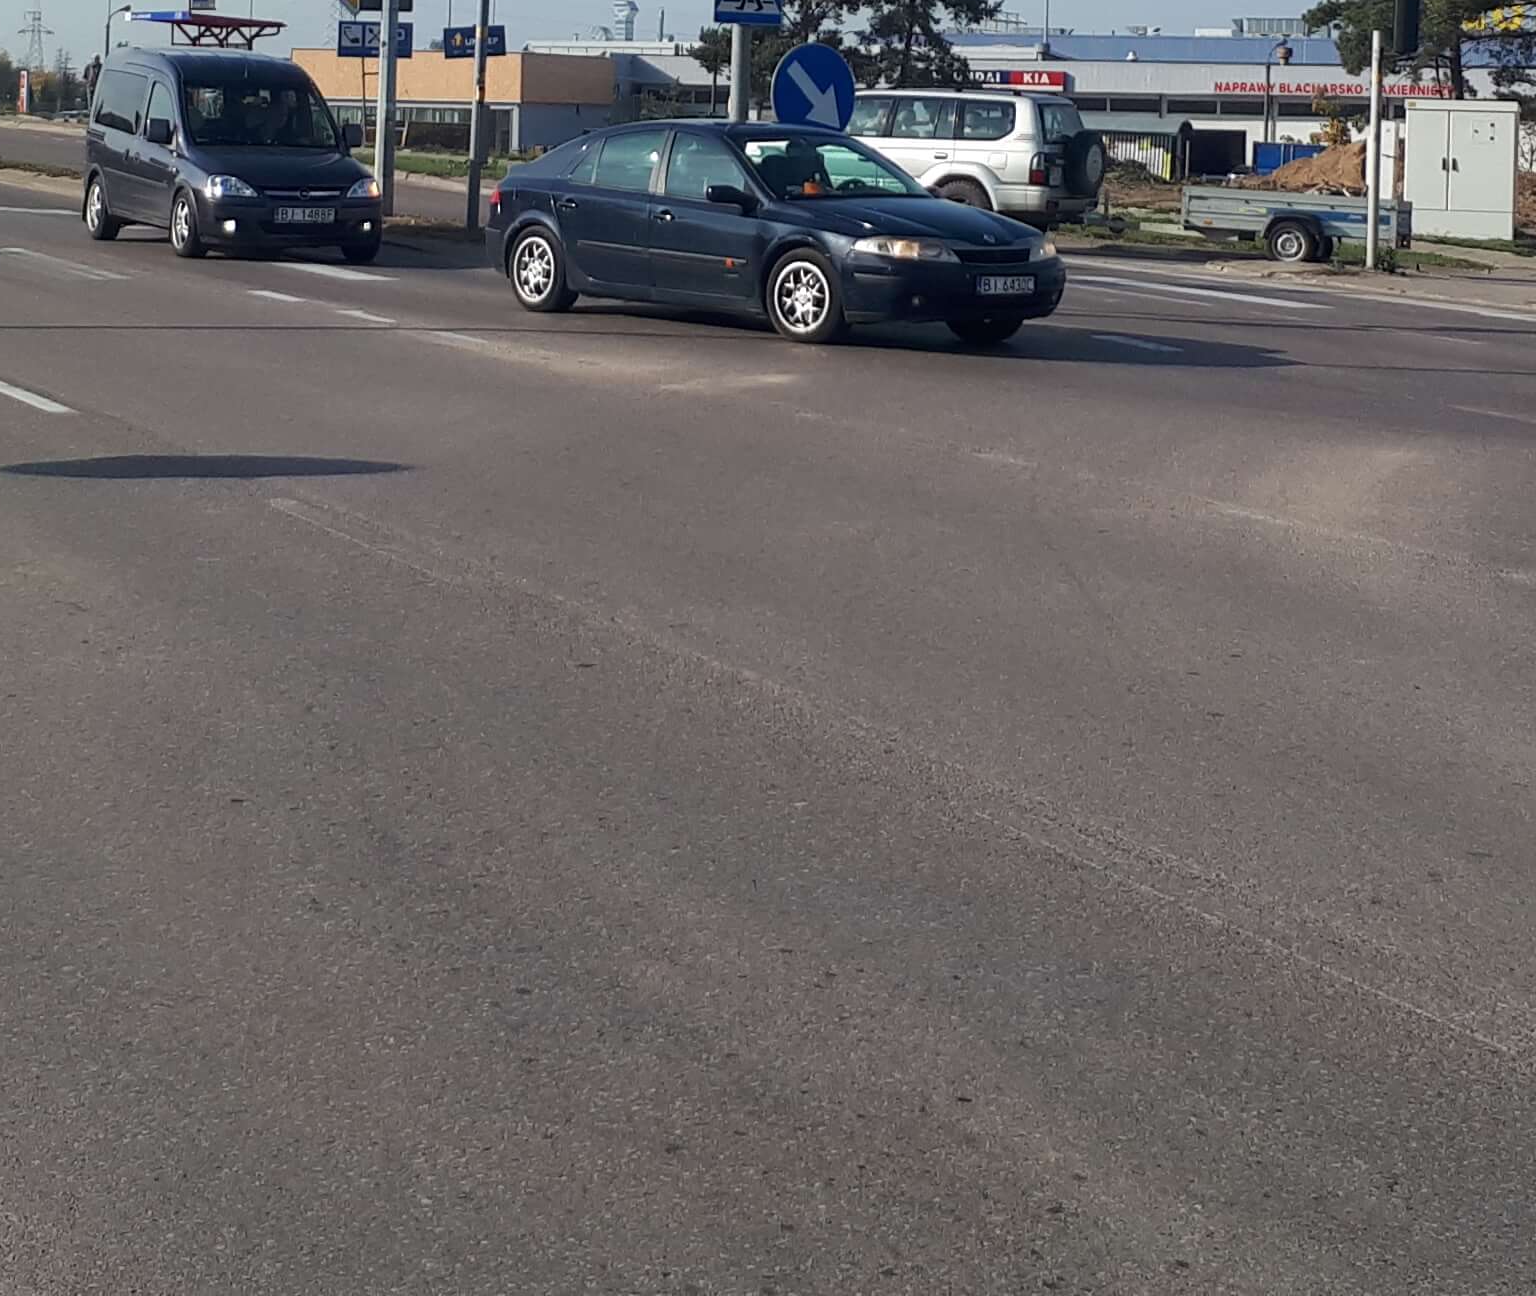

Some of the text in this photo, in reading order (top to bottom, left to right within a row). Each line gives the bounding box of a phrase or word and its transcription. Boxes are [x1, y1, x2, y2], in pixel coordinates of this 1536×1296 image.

[1023, 72, 1050, 84] KIA
[1214, 82, 1275, 93] NAPRAWY
[983, 278, 997, 292] BI
